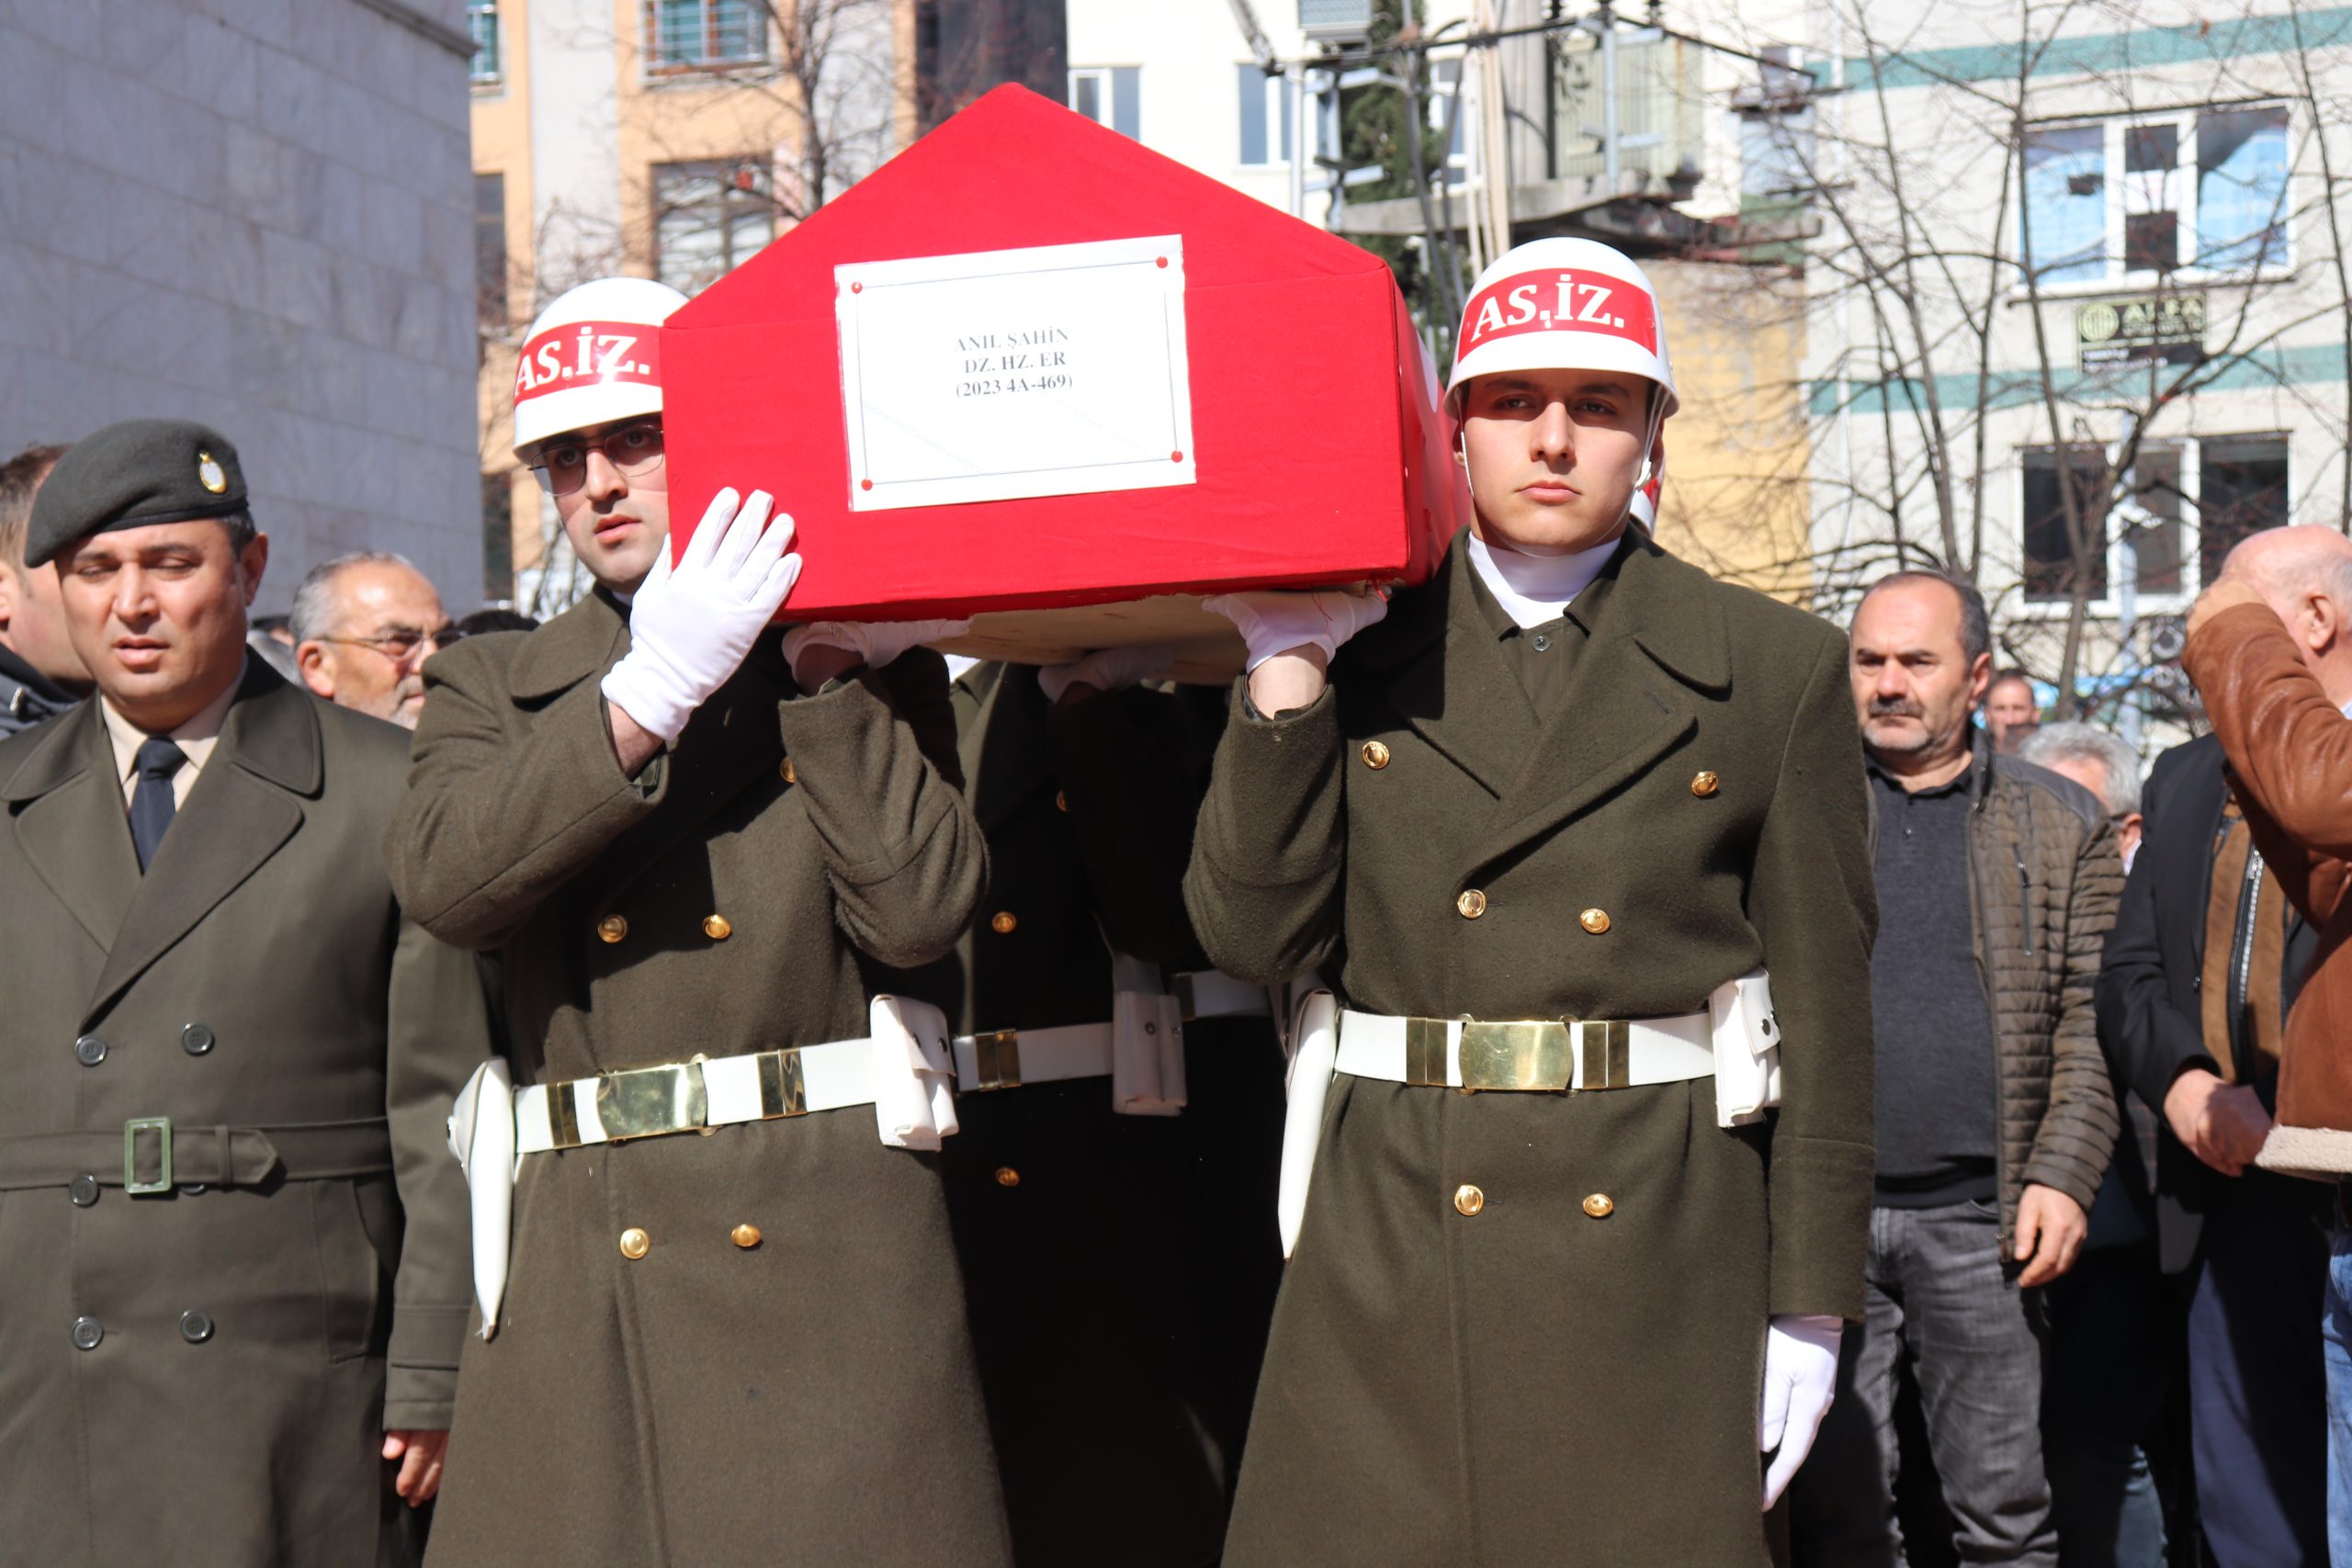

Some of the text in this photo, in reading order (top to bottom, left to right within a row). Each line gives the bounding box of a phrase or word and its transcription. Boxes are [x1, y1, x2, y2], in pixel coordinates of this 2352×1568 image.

[1471, 274, 1624, 343] AS.İZ.
[956, 325, 1069, 352] ANIL ŞAHİN
[514, 326, 650, 398] AS.İZ.
[965, 351, 1067, 374] DZ. HZ. ER
[956, 374, 1073, 400] (2023 4A-469)
